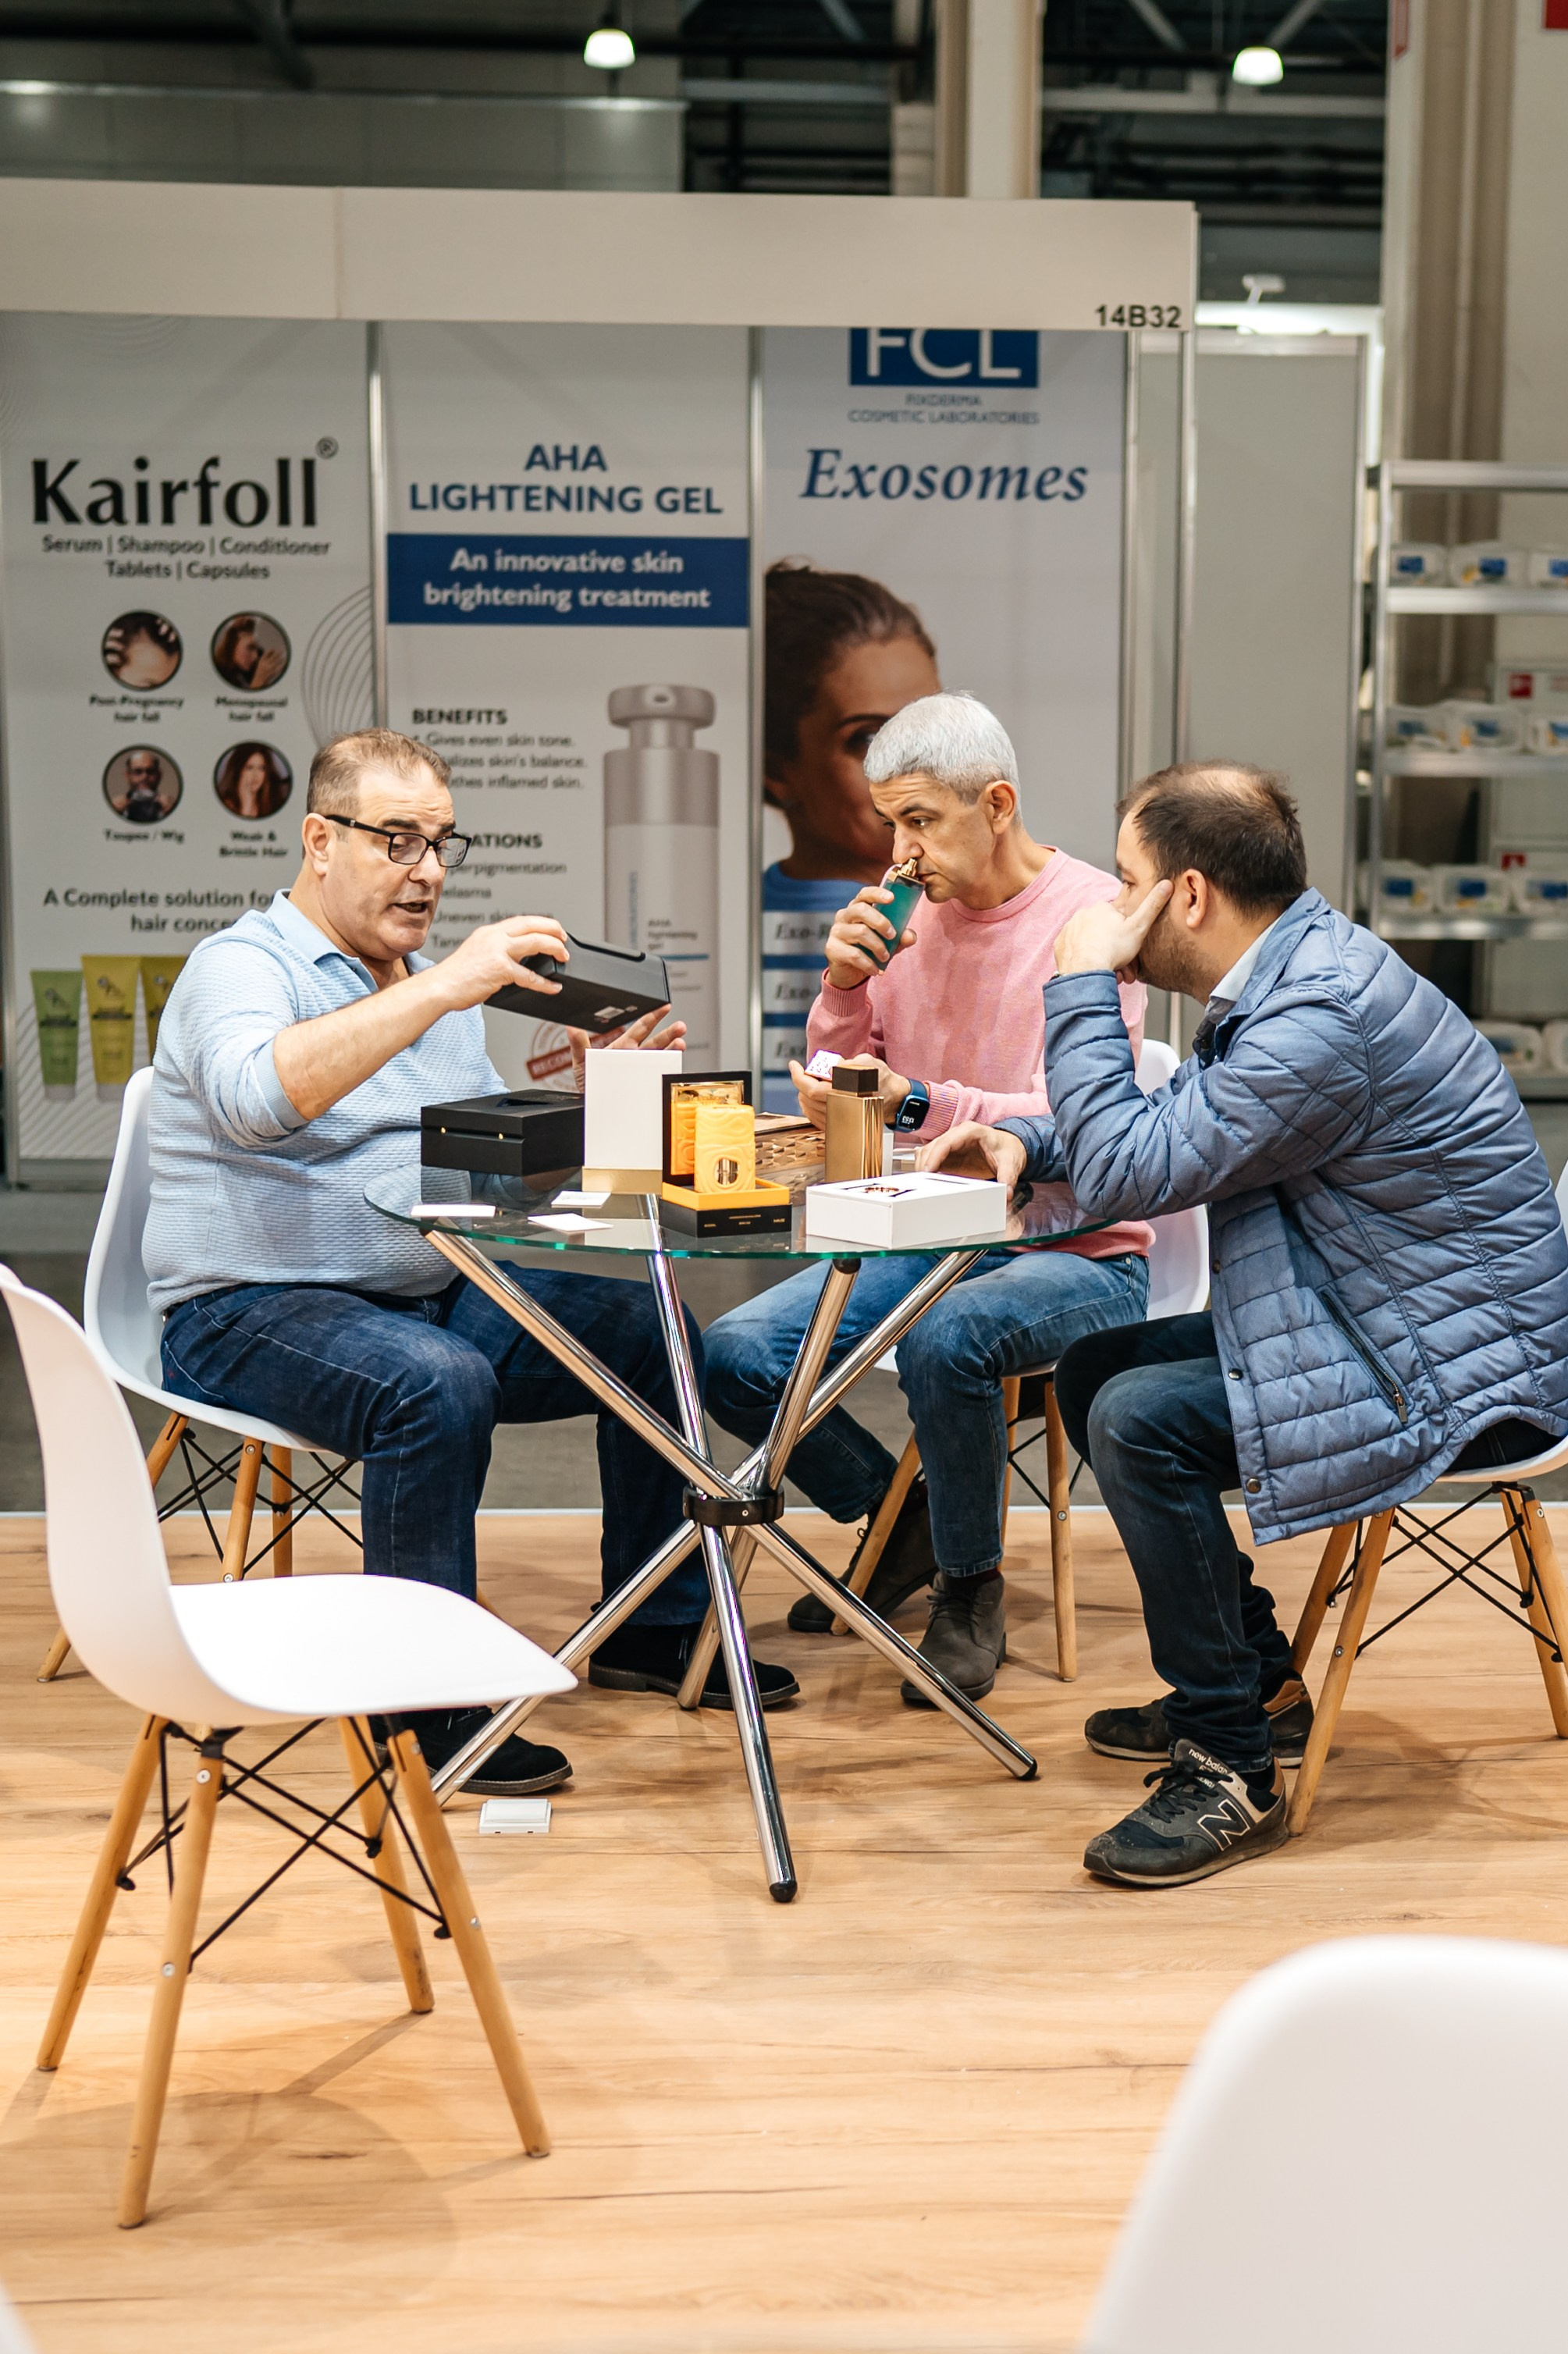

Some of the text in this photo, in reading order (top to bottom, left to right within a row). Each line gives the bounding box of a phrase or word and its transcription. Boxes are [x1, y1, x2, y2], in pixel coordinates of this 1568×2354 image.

[1094, 304, 1182, 328] 14B32
[866, 329, 1022, 379] FCL
[848, 410, 1040, 425] COSMETIC LABORATORIES
[524, 444, 608, 471] AHA
[799, 449, 1090, 502] Exosomes
[410, 483, 724, 514] LIGHTENING GEL
[42, 535, 102, 553] Serum
[118, 536, 204, 556] Shampoo
[220, 536, 330, 555] Conditioner
[105, 559, 172, 578] Tablets
[187, 560, 270, 580] Capsules
[450, 548, 684, 574] An innovative skin
[424, 583, 711, 613] brightening treatment
[412, 709, 507, 724] BENEFITS
[426, 731, 465, 746] Gives
[469, 735, 503, 746] even
[507, 733, 535, 746] skin
[446, 754, 485, 768] alizes
[450, 775, 483, 788] othes
[488, 774, 548, 788] inflamed
[462, 833, 543, 848] ATIONS
[450, 863, 567, 877] perpigmentation
[44, 887, 59, 906] A
[63, 887, 159, 910] Complete
[165, 889, 244, 908] solution
[442, 887, 492, 898] elasma
[131, 913, 167, 932] hair
[1188, 1748, 1207, 1763] new
[1205, 1756, 1228, 1774] balan
